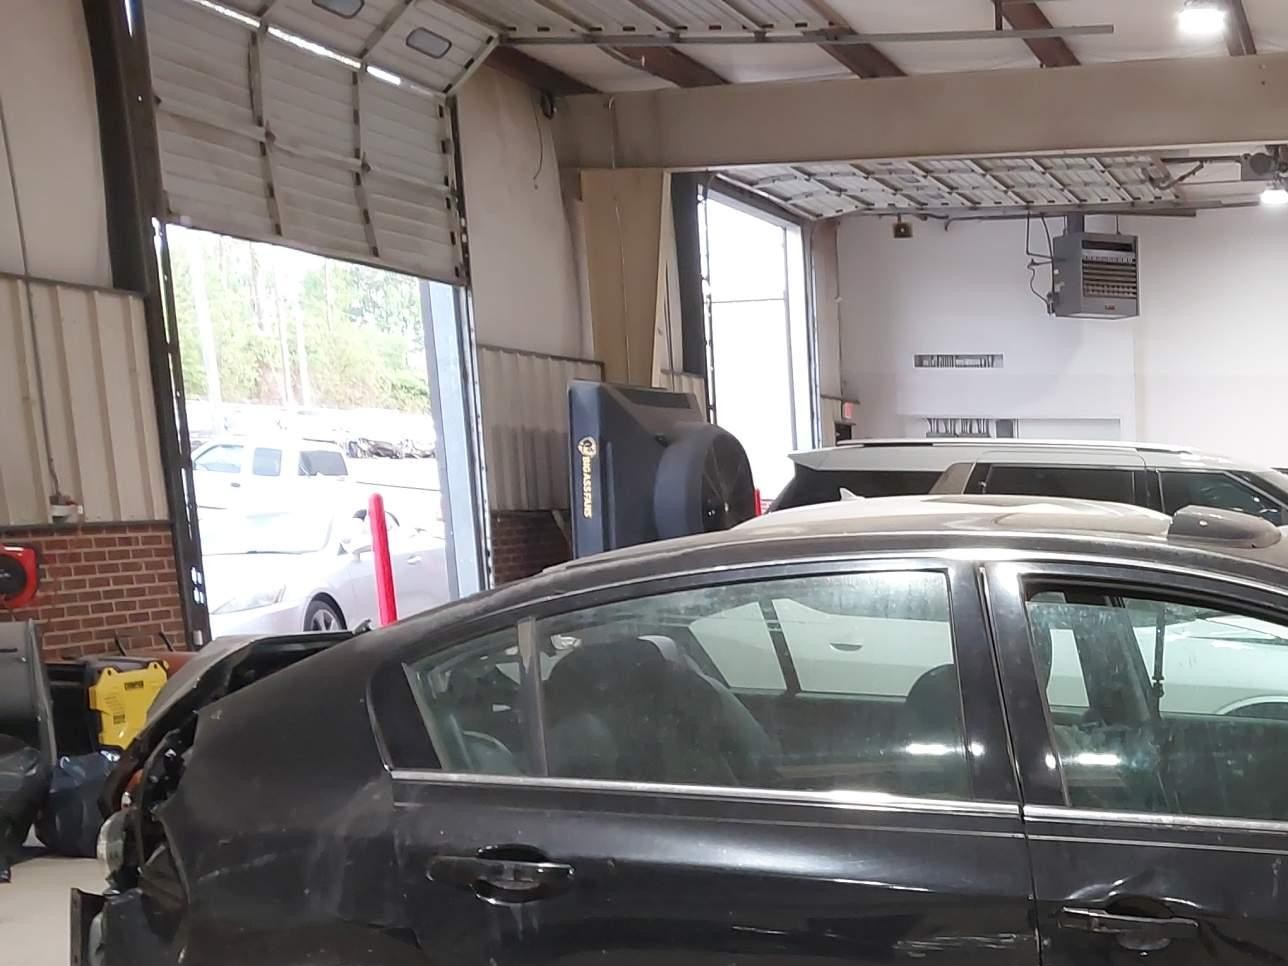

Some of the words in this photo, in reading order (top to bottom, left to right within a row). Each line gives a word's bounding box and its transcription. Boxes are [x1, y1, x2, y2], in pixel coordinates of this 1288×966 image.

[582, 456, 592, 473] BIG
[583, 473, 592, 493] ASS
[583, 493, 593, 519] FANS
